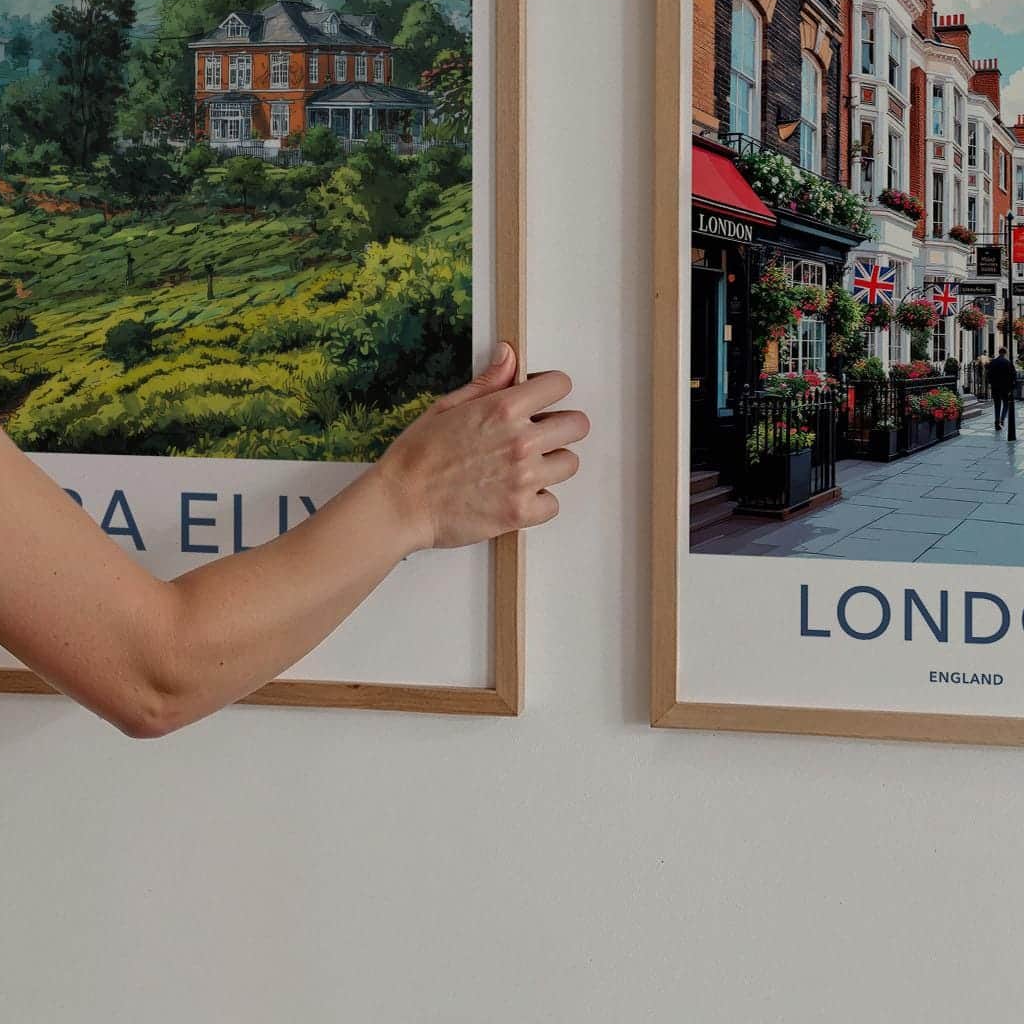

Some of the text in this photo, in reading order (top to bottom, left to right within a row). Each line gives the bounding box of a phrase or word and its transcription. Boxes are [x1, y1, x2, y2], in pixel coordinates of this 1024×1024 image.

[698, 213, 753, 242] LONDON
[180, 492, 317, 553] ELI
[800, 584, 1024, 645] LOND
[929, 671, 1004, 686] ENGLAND
